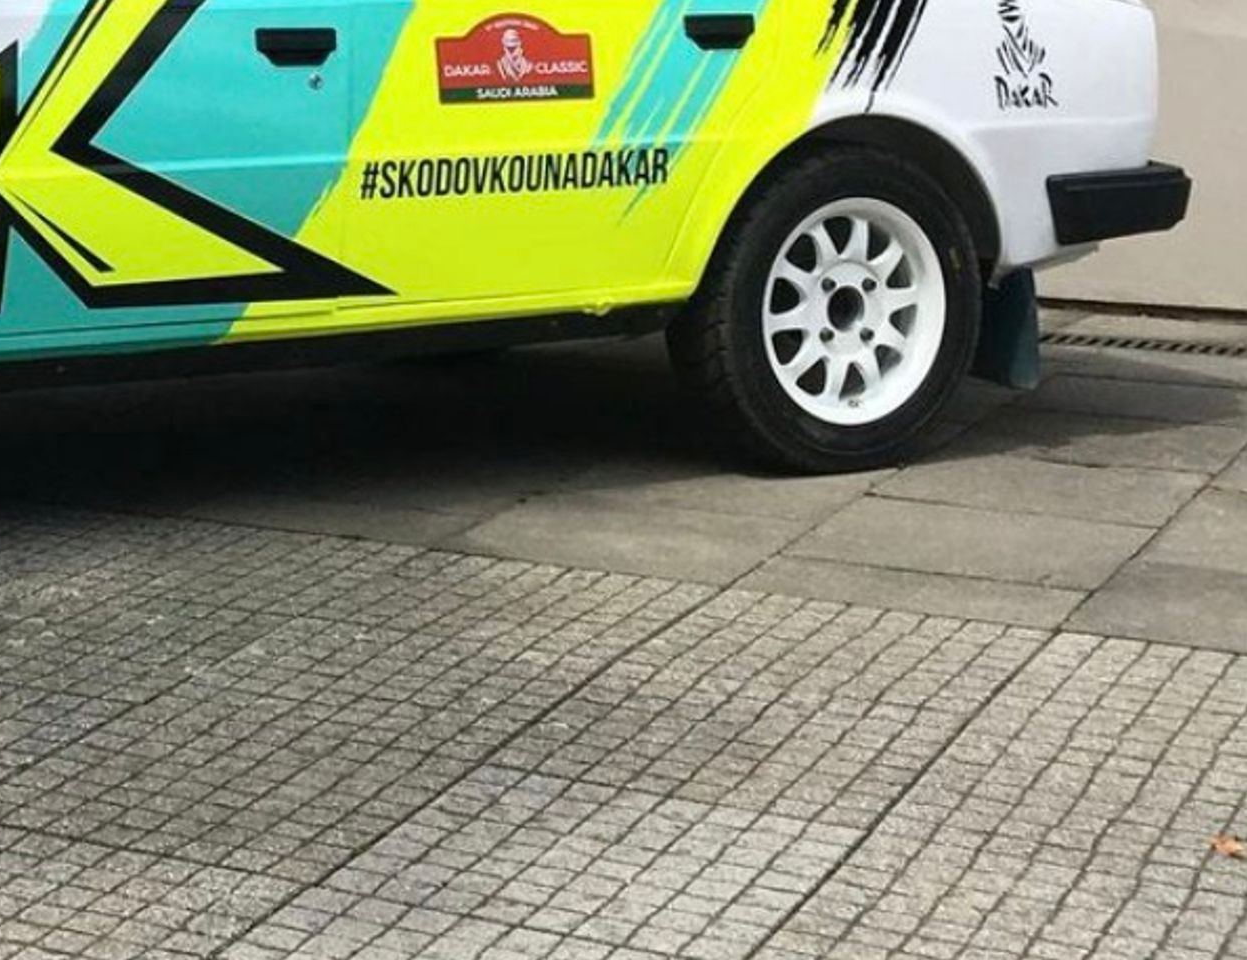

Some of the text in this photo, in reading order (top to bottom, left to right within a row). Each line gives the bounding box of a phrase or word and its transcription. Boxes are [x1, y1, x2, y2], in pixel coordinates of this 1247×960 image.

[444, 60, 589, 77] DAKAR CLASSIC
[476, 86, 559, 99] SAUDI ARABIA
[360, 148, 669, 200] #SKODOVKOUNADAKAR
